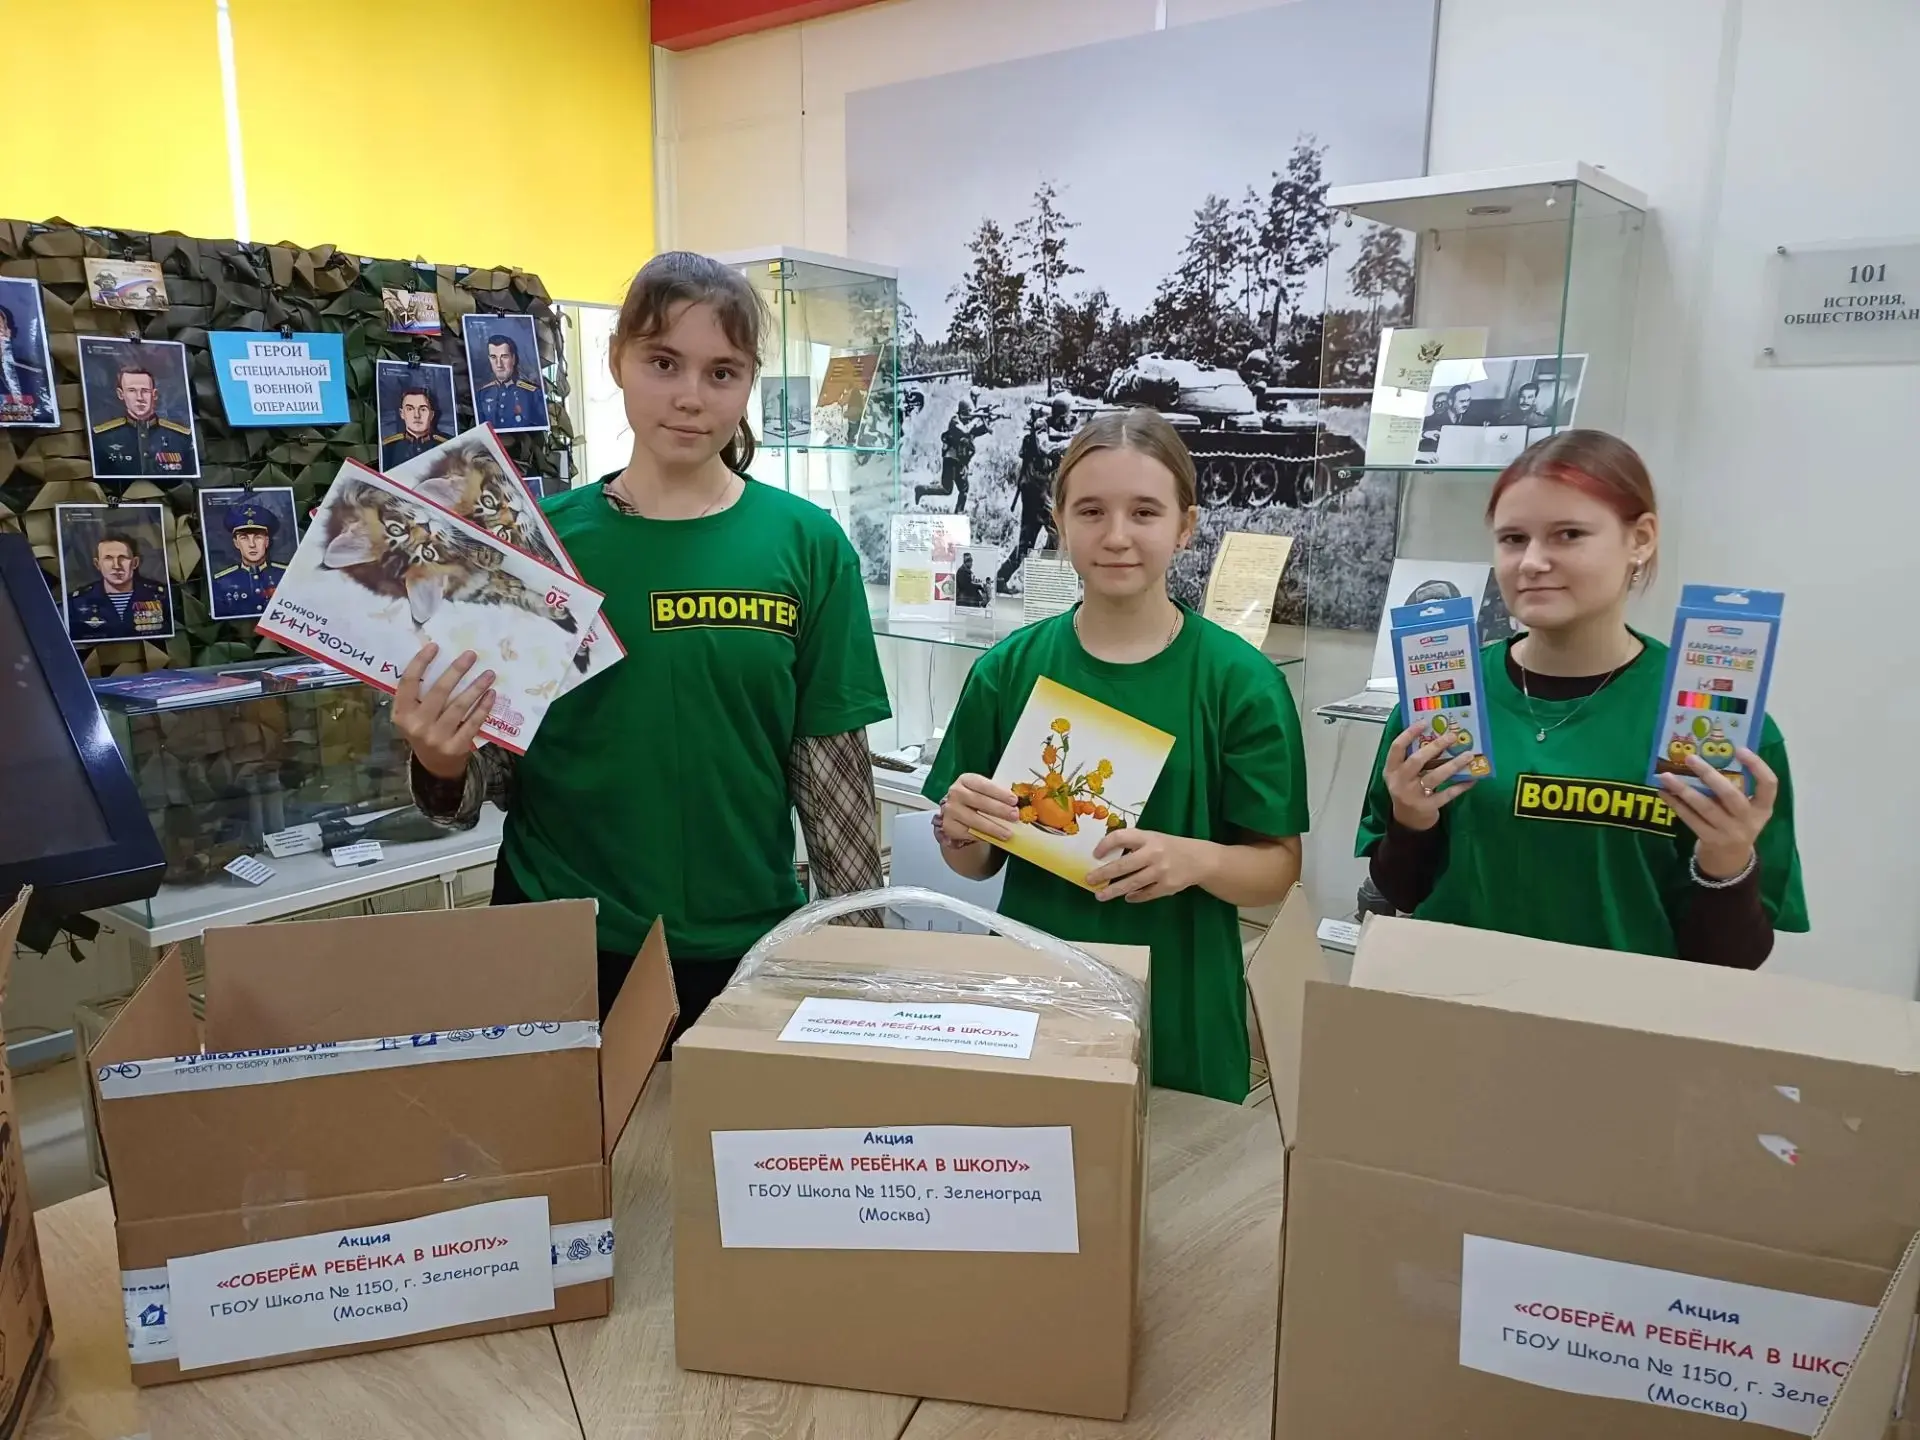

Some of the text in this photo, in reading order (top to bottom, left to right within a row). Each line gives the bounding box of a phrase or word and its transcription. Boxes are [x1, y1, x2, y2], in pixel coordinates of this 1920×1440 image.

[1848, 263, 1886, 283] 101
[1823, 294, 1906, 308] ИСТОРИЯ,
[254, 344, 302, 357] ГЕРОИ
[234, 364, 328, 378] СПЕЦИАЛЬНОЙ
[254, 382, 313, 394] ВОЕННОЙ
[253, 401, 319, 412] ОПЕРАЦИИ
[545, 591, 568, 610] 20
[277, 598, 328, 626] БЛОКНОТ
[656, 596, 797, 627] ВОЛОНТЕР
[269, 608, 403, 679] ЛЯ РИСОВАНИЯ
[1688, 641, 1757, 655] КАРАНДАШИ
[1408, 648, 1465, 661] КАРАНДАШИ
[1686, 652, 1755, 670] ЦВЕТНЫЕ
[1409, 659, 1466, 675] ЦВЕТНЫЕ
[894, 1011, 942, 1019] Акция
[881, 1021, 941, 1032] РЕБЁНКА
[961, 1027, 1020, 1037] ШКОЛУ»
[174, 1063, 213, 1076] ПРОЕКТ
[217, 1062, 233, 1072] ПО
[236, 1058, 270, 1070] СБОРУ
[863, 1131, 914, 1146] Акция
[754, 1153, 1030, 1173] «СОБЕРЁМ РЕБЁНКА В ШКОЛУ»
[748, 1183, 1042, 1204] ГБОУ Школа № 1150, г. Зеленоград
[858, 1206, 931, 1225] (Москва)
[338, 1233, 391, 1248] Акция
[216, 1236, 509, 1289] «СОБЕРЁМ РЕБЁНКА В ШКОЛУ»
[210, 1260, 520, 1317] ГБОУ Школа № 1150, г. Зеленоград
[333, 1297, 408, 1322] (Москва)
[1668, 1299, 1740, 1325] Акция
[1514, 1302, 1636, 1337] «СОБЕРЁМ
[1646, 1323, 1754, 1360] РЕБЁНКА
[1766, 1348, 1781, 1364] В
[1502, 1326, 1830, 1407] ГБОУ Школа № 1150, г. Зеле
[1648, 1383, 1747, 1421] (Москва)
